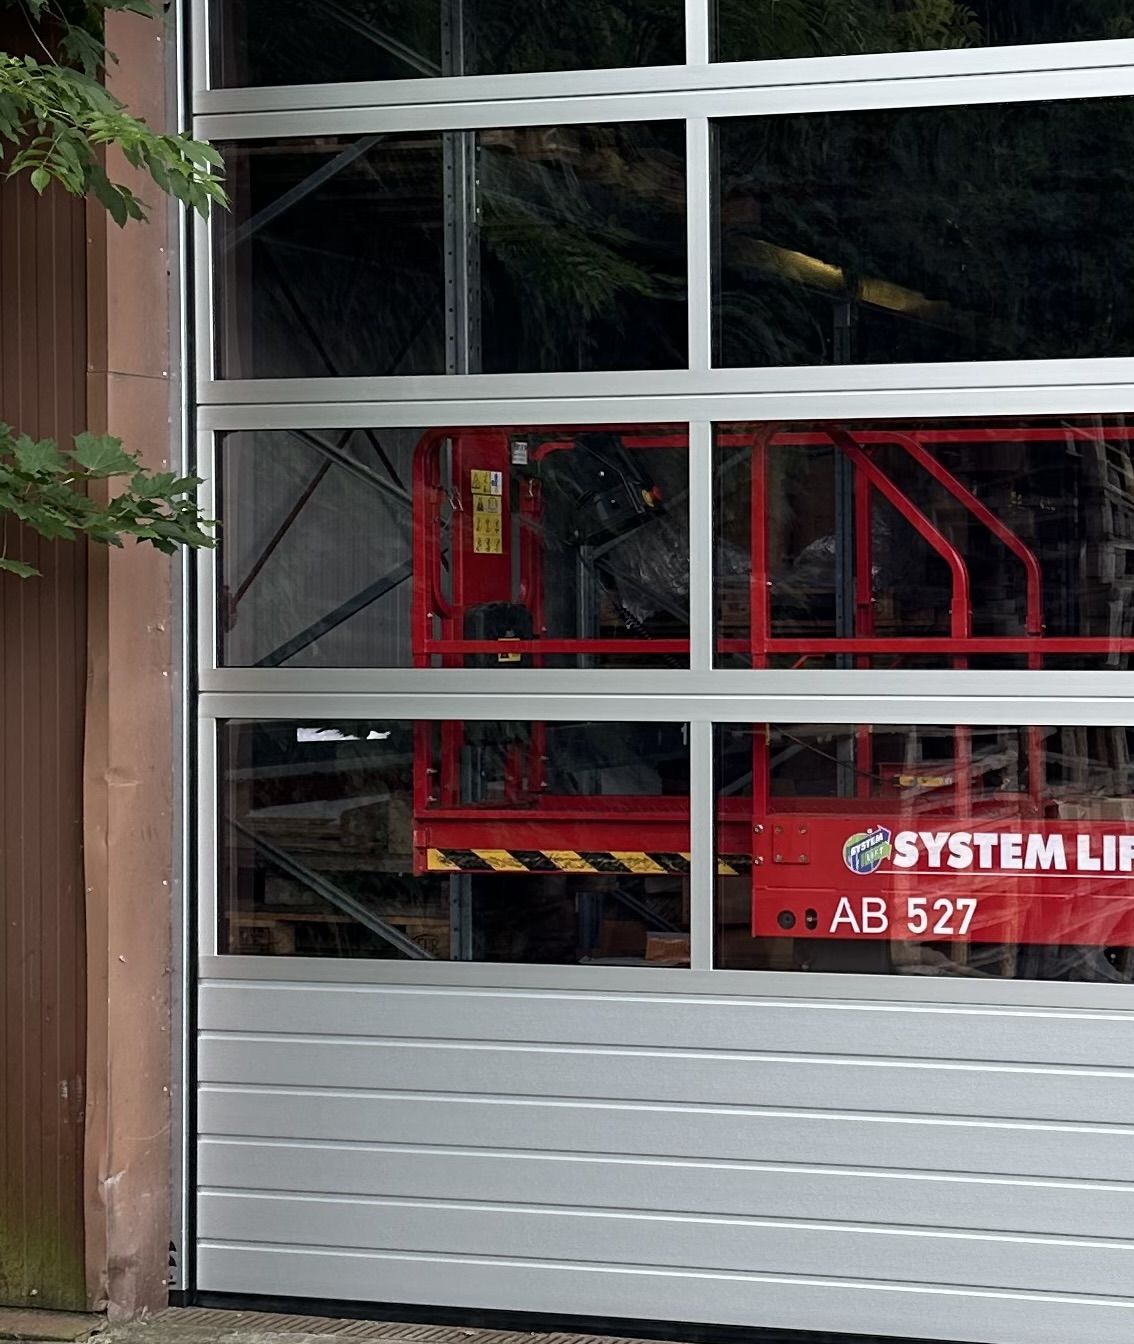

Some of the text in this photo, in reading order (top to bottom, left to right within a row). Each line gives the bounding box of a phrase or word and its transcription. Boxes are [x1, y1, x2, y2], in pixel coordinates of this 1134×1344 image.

[893, 830, 1067, 870] SYSTEM
[829, 896, 977, 935] AB 527
